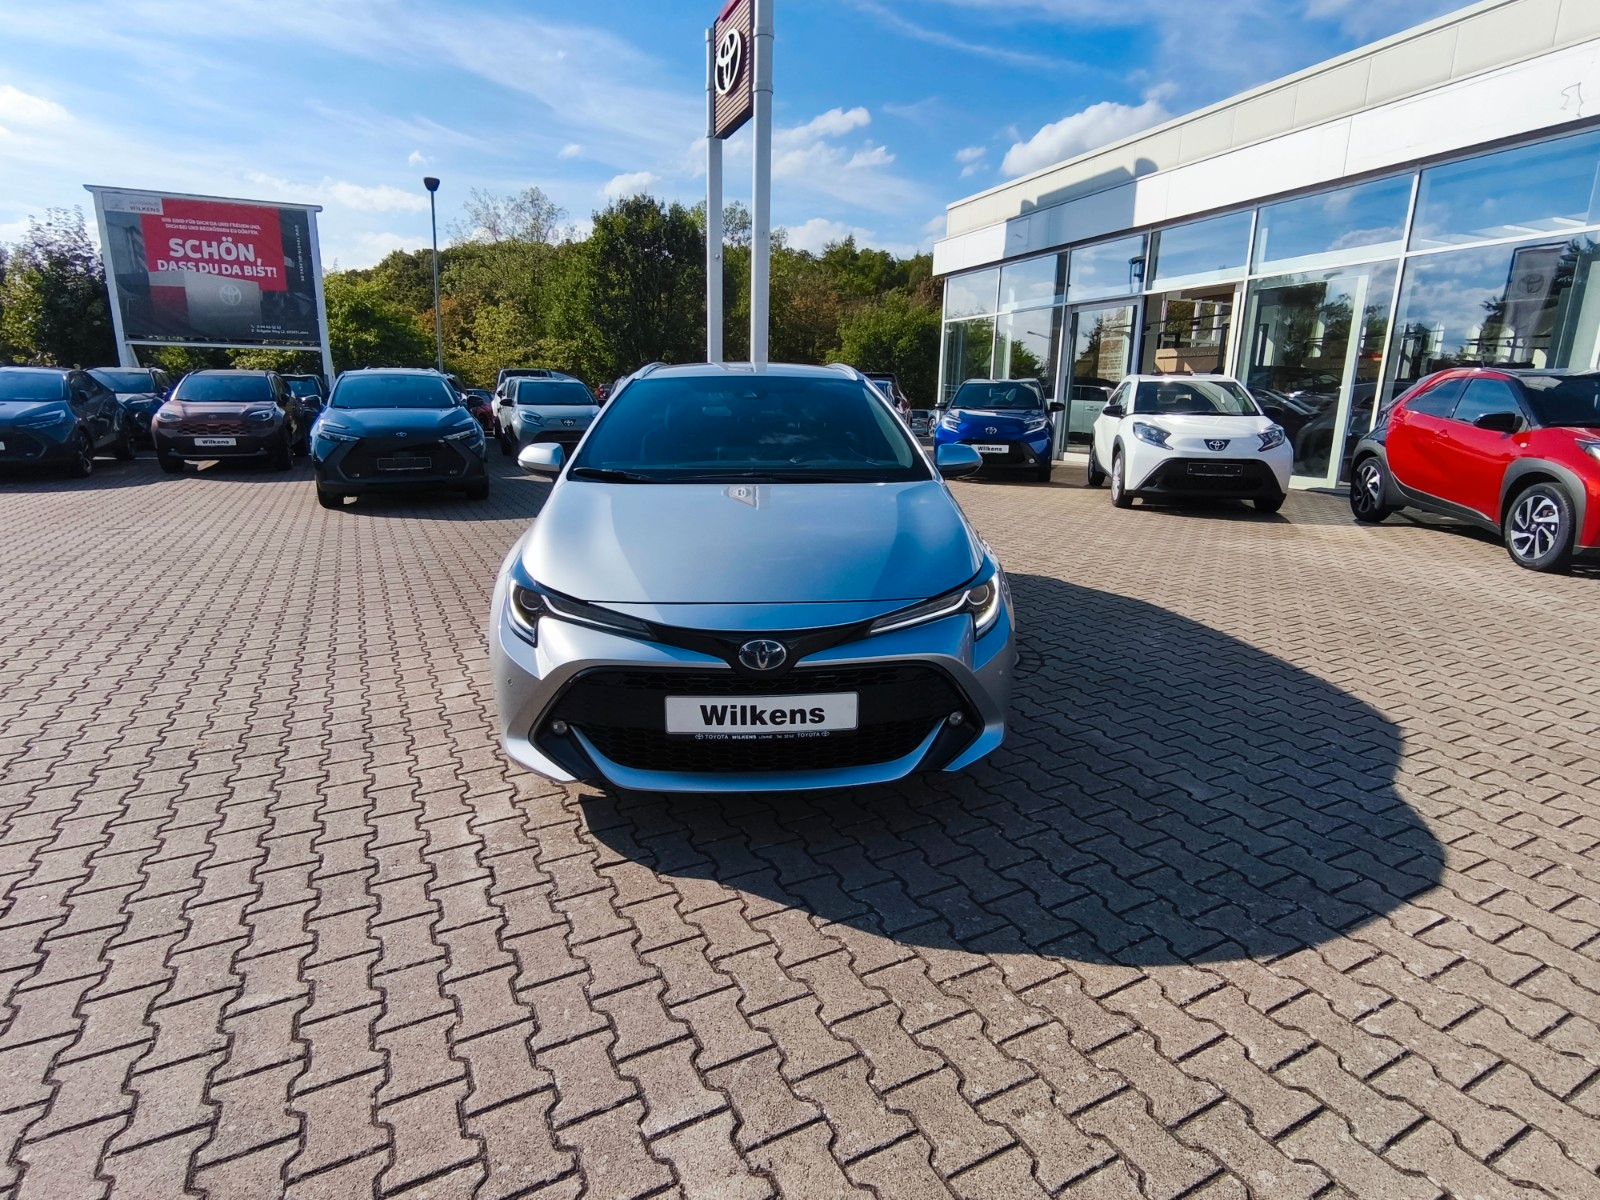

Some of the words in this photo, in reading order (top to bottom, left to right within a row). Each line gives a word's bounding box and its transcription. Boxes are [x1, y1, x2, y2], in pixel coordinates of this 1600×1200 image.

[169, 236, 262, 267] SCHÖN,
[157, 259, 196, 272] DASS
[198, 262, 219, 274] DU
[221, 263, 242, 276] DA
[243, 265, 277, 278] BIST!
[699, 704, 826, 726] Wilkens
